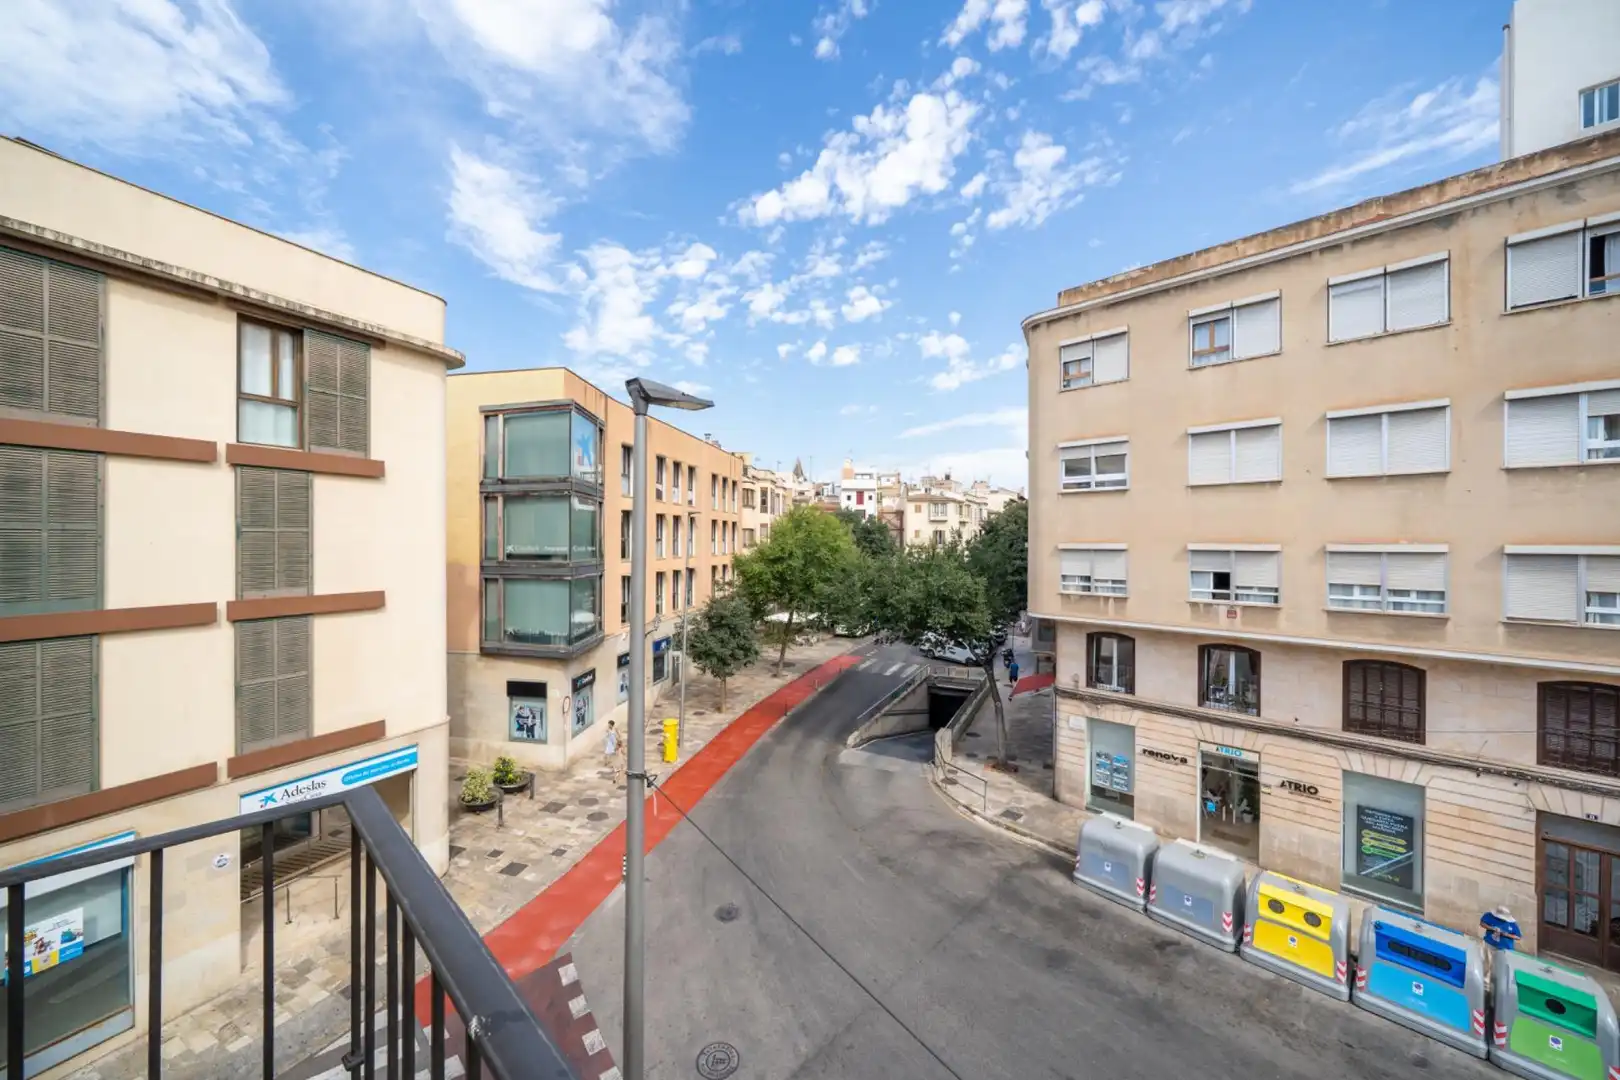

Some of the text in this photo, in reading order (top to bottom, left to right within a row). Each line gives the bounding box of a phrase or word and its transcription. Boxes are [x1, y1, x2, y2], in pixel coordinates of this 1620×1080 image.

[1142, 748, 1188, 764] renova
[1216, 746, 1242, 757] ATRIO
[280, 780, 326, 800] Adeslas
[1280, 780, 1319, 795] ATRIO
